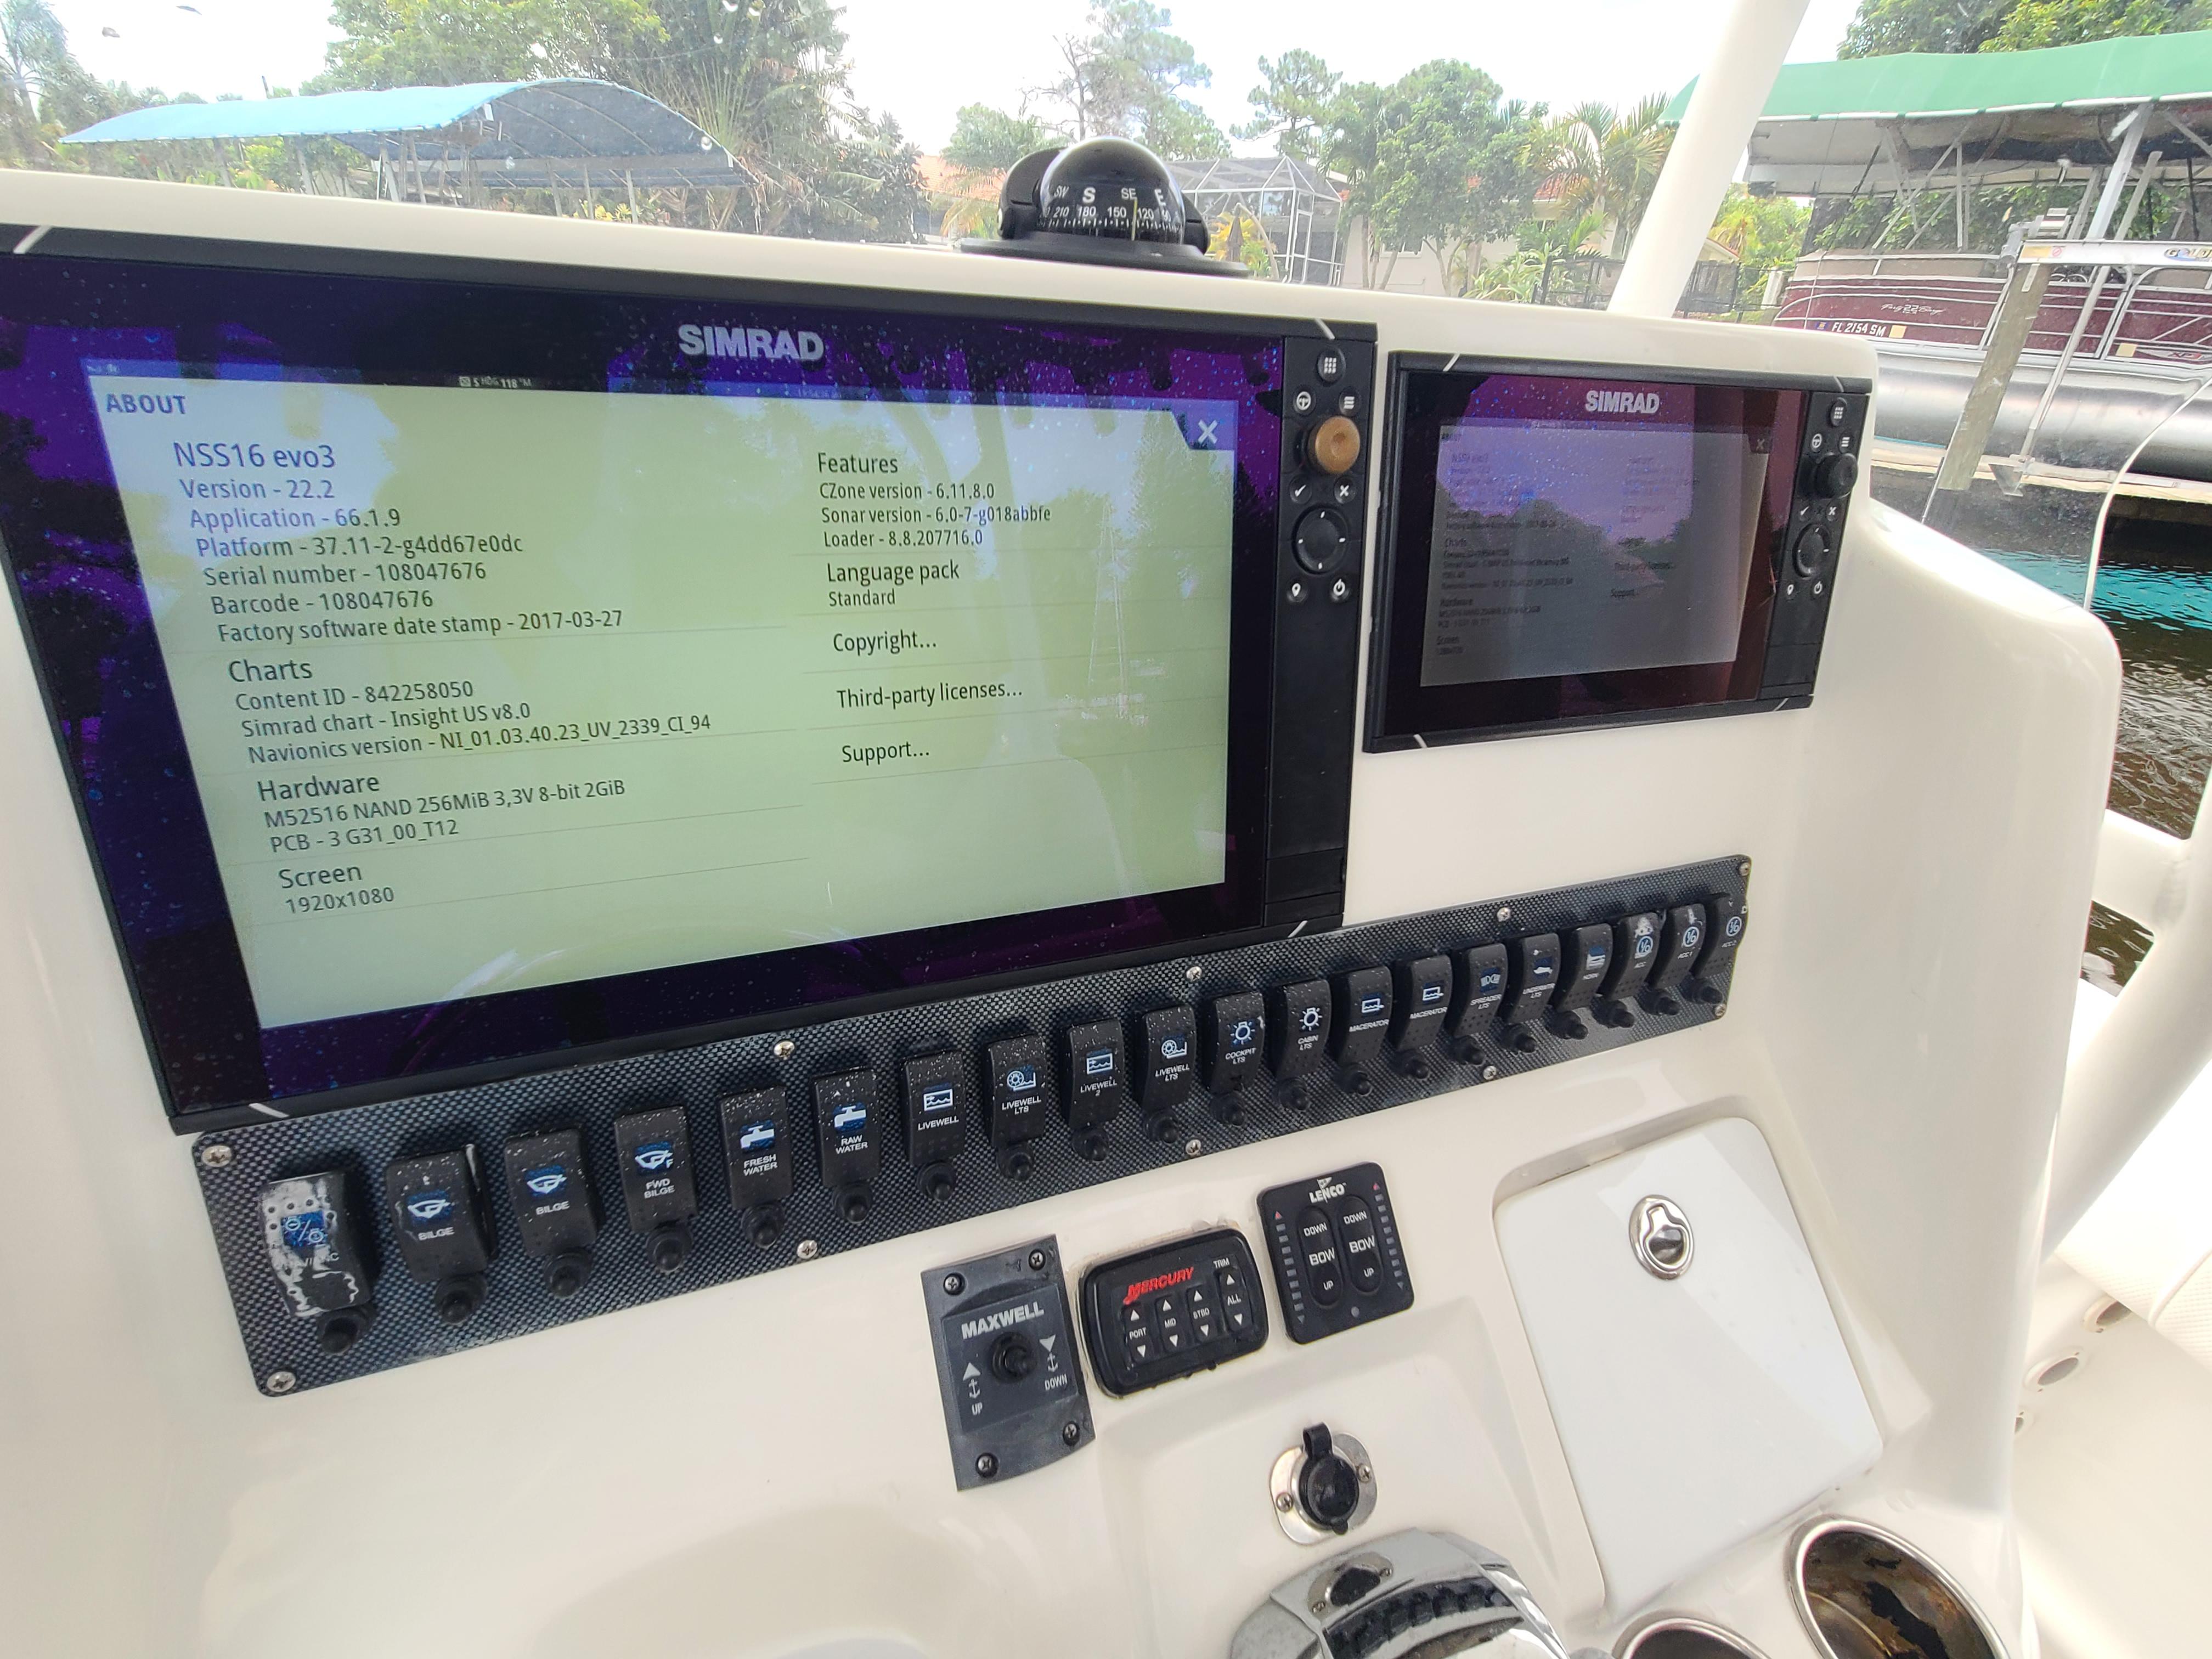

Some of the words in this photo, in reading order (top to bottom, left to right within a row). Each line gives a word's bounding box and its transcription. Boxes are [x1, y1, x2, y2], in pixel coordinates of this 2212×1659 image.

[1054, 185, 1069, 198] SW
[1082, 187, 1096, 204] S
[1121, 188, 1137, 200] SE
[1155, 189, 1166, 206] E
[1053, 206, 1069, 218] 210
[1077, 206, 1097, 218] 180
[1107, 206, 1127, 218] 150
[1137, 208, 1154, 220] 120
[1831, 322, 1842, 332] FL
[1844, 323, 1868, 334] 2154
[1869, 324, 1887, 337] SM
[678, 324, 824, 360] SIMRAD
[105, 394, 187, 415] ABOUT
[1585, 391, 1660, 414] SIMRAD
[173, 442, 266, 468] NSS16
[274, 445, 336, 469] evo3
[817, 452, 898, 473] Features
[179, 478, 266, 499] Version
[286, 480, 335, 499] 22.2
[820, 483, 866, 499] CZone
[868, 482, 922, 500] version
[936, 482, 995, 499] 6.11.8.0
[190, 509, 315, 533] Application
[335, 509, 400, 528] 66.1.9
[821, 507, 866, 523] Sonar
[868, 506, 922, 523] version
[935, 505, 1051, 526] 6.0-7-g018abbfe
[196, 538, 293, 558] Platform
[313, 534, 523, 559] 37.11-2-g4dd67e0dc
[823, 530, 874, 548] Loader
[888, 529, 983, 548] 8.8.207716.0
[204, 566, 266, 586] Serial
[273, 564, 356, 584] number
[377, 561, 487, 582] 108047676
[827, 561, 915, 586] Language
[919, 559, 960, 585] pack
[211, 593, 300, 615] Barcode
[320, 590, 433, 611] 108047676
[828, 588, 896, 607] Standard
[218, 622, 295, 646] Factory
[300, 616, 388, 639] software
[393, 615, 437, 635] date
[441, 616, 501, 636] stamp
[517, 610, 623, 631] 2017-03-27
[833, 629, 937, 656] Copyright...
[228, 658, 313, 683] Charts
[235, 690, 317, 711] Content
[324, 687, 346, 706] ID
[365, 681, 473, 704] 842258050
[836, 684, 936, 710] Third-party
[940, 682, 1024, 702] licenses...
[241, 715, 317, 738] Simrad
[322, 712, 374, 733] chart
[391, 706, 458, 730] Insight
[463, 704, 489, 722] US
[492, 702, 531, 721] v8.0
[247, 741, 347, 764] Navionics
[352, 735, 422, 756] version
[841, 741, 929, 766] Support...
[257, 775, 381, 802] Hardware
[264, 804, 348, 828] M52516
[353, 798, 412, 820] NAND
[417, 791, 489, 814] 256MiB
[493, 787, 534, 808] 3,3V
[538, 783, 581, 802] 8-bit
[584, 779, 625, 798] 2GiB
[270, 833, 310, 853] PCB
[329, 831, 341, 848] 3
[346, 819, 459, 845] G31_00_T12
[278, 864, 363, 889] Screen
[285, 887, 395, 914] 1920x1080
[1410, 1007, 1448, 1019] MACERATOR
[1349, 1019, 1389, 1032] MACERATOR
[1298, 1035, 1319, 1045] CABIN
[1300, 1041, 1313, 1051] LTS
[1225, 1047, 1256, 1061] COCKPIT
[1233, 1056, 1245, 1065] LTS
[1155, 1063, 1190, 1077] LIVEWELL
[1165, 1071, 1178, 1081] LTS
[1080, 1079, 1118, 1093] LIVEWELL
[1002, 1096, 1042, 1111] LIVEWELL
[1014, 1105, 1029, 1115] LTS
[917, 1116, 960, 1131] LIVEWELL
[836, 1141, 868, 1154] WATER
[841, 1135, 863, 1147] RAW
[743, 1154, 777, 1169] FRESH
[743, 1161, 778, 1177] WATER
[644, 1185, 675, 1199] BILGE
[646, 1178, 670, 1190] FWD
[1309, 1184, 1345, 1203] LENCO
[536, 1200, 570, 1216] BILGE
[1344, 1210, 1368, 1225] DOWN
[418, 1227, 455, 1241] BILGE
[1304, 1222, 1328, 1237] DOWN
[1349, 1235, 1375, 1254] BOW
[1213, 1257, 1230, 1268] TRIM
[1309, 1248, 1335, 1266] BOW
[1363, 1267, 1374, 1278] UP
[1123, 1267, 1194, 1305] MERCURY
[1323, 1280, 1334, 1290] UP
[1227, 1294, 1242, 1306] ALL
[961, 1302, 1045, 1340] MAXWELL
[1193, 1308, 1210, 1319] STBD
[1164, 1318, 1177, 1328] MID
[1129, 1327, 1147, 1339] PORT
[1045, 1374, 1068, 1391] DOWN
[972, 1402, 983, 1415] UP
